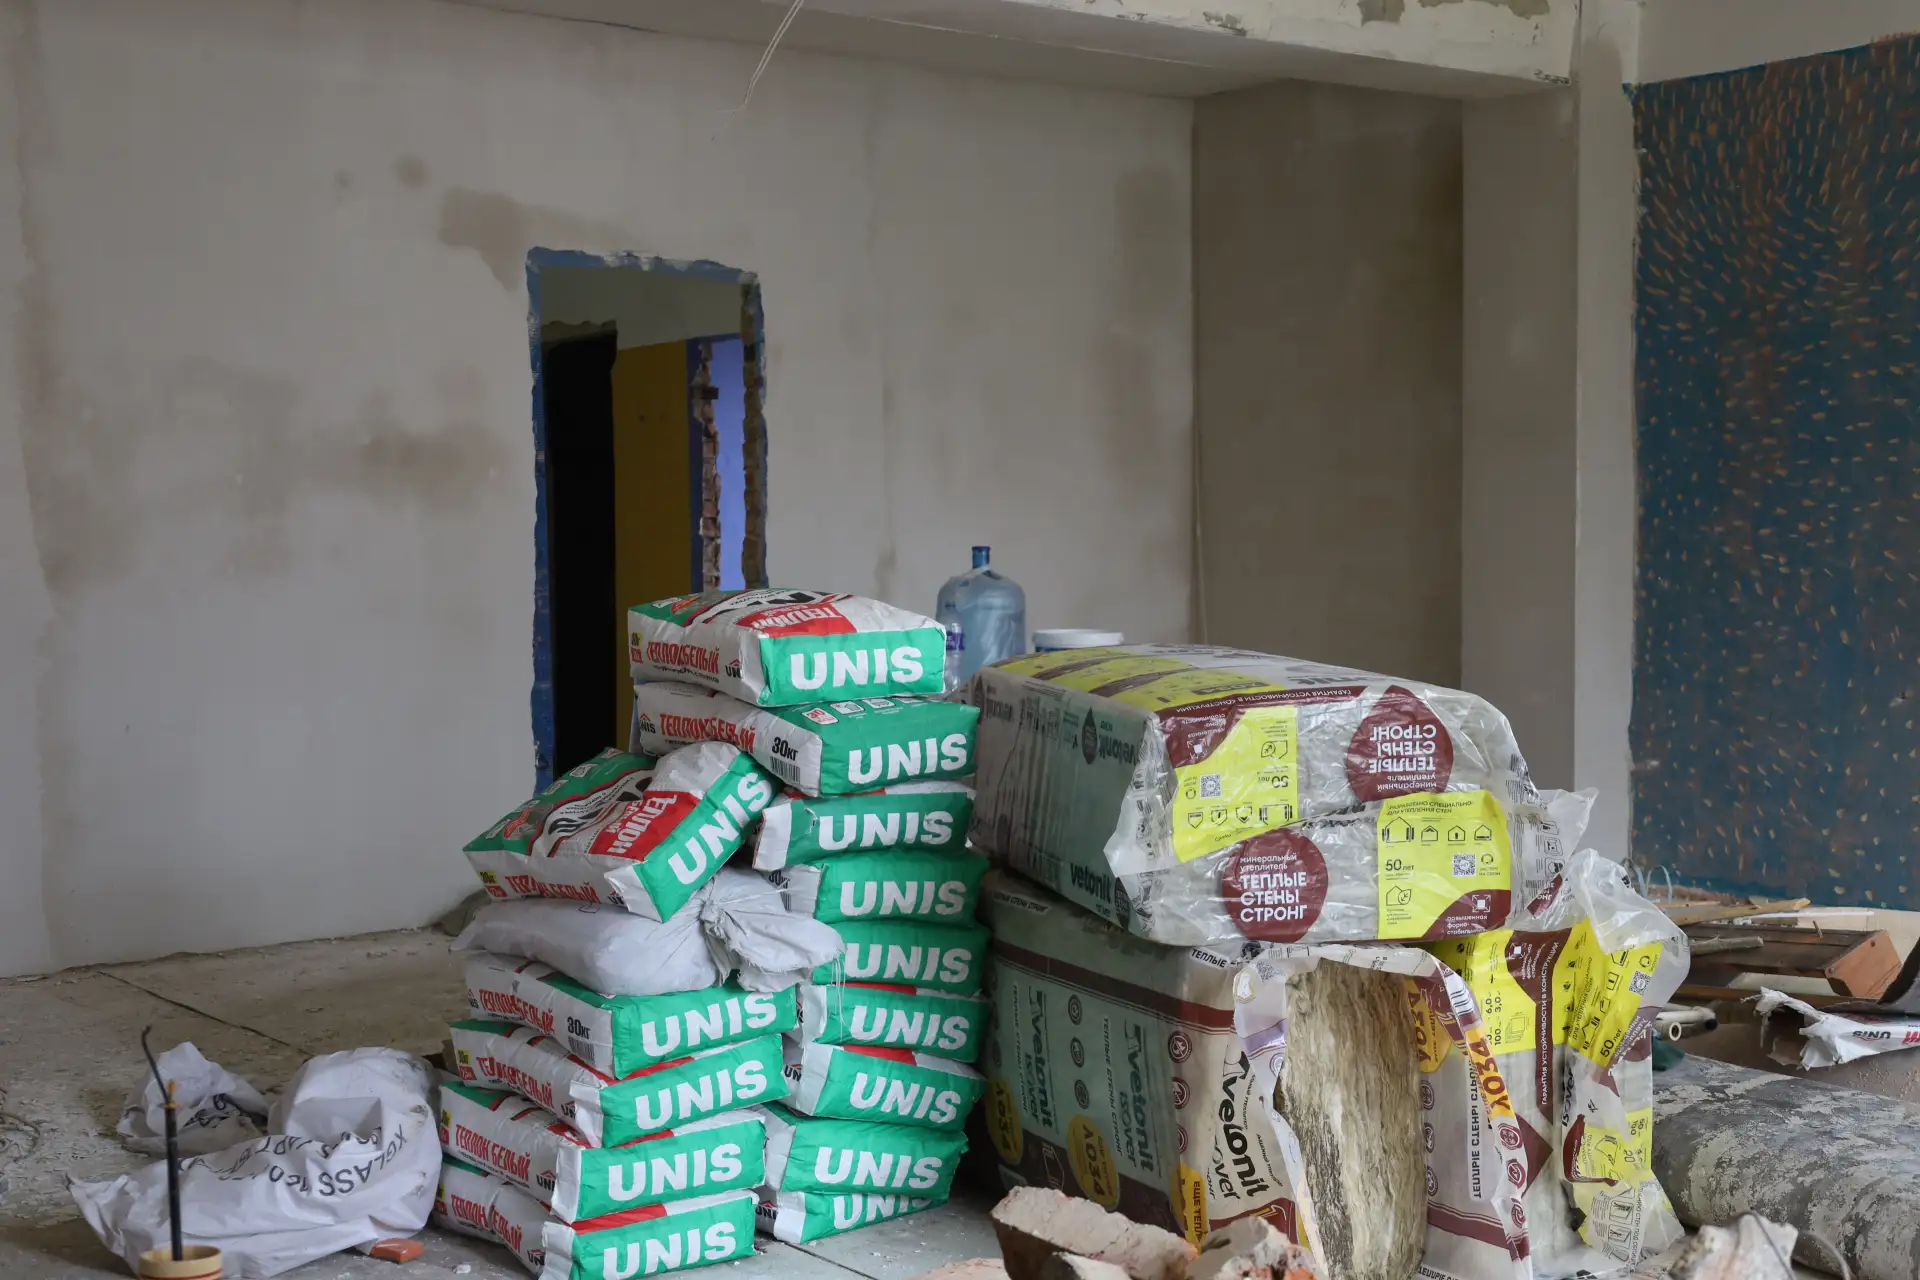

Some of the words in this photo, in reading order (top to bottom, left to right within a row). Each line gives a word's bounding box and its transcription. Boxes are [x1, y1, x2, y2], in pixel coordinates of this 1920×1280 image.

[725, 665, 743, 678] UN
[790, 646, 924, 690] UNIS
[1245, 690, 1311, 704] УСТОЙЧИВОСТИ
[1312, 688, 1352, 698] ГАРАНТИЯ
[1370, 724, 1437, 740] СТРОНГ
[772, 736, 799, 761] 30кг
[848, 733, 968, 785] UNIS
[1377, 740, 1436, 756] СТЕНЫ
[1368, 757, 1436, 773] ТЕПЛЫЕ
[1387, 772, 1436, 781] утеплитель
[1271, 775, 1289, 788] 50
[1377, 782, 1437, 792] минеральный
[616, 793, 679, 853] ТЕПЛОН
[667, 771, 772, 886] UNIS
[818, 810, 954, 850] UNIS
[1240, 853, 1297, 863] минеральный
[1240, 863, 1288, 873] утеплитель
[1385, 859, 1402, 871] 50
[1070, 863, 1112, 905] vetonit
[1240, 871, 1307, 890] ТЕПЛЫЕ
[839, 880, 968, 917] UNIS
[1240, 889, 1300, 906] СТЕНЫ
[1240, 904, 1307, 923] СТРОНГ
[844, 943, 973, 984] UNIS
[1190, 948, 1228, 969] ТЕПЛЫЕ
[1542, 942, 1560, 993] КОНСТРУКЦИИ
[567, 1016, 591, 1040] 30кг
[641, 991, 777, 1057] UNIS
[849, 1005, 970, 1050] UNIS
[1494, 1028, 1502, 1046] 100
[1851, 1030, 1892, 1040] UNIS
[1600, 1040, 1614, 1058] 50
[1613, 1028, 1622, 1042] лет
[784, 1065, 802, 1082] UN
[1030, 1014, 1053, 1128] vetonit
[635, 1059, 768, 1130] UNIS
[849, 1072, 961, 1124] UNIS
[1561, 1068, 1574, 1127] isover
[1127, 1053, 1155, 1173] vetonit
[1219, 1075, 1270, 1198] vetonit
[456, 1124, 490, 1161] ТЕПЛОН
[491, 1142, 532, 1182] БЕЛЫЙ
[608, 1143, 742, 1201] UNIS
[814, 1146, 942, 1190] UNIS
[536, 1174, 556, 1192] UNI
[1193, 1180, 1201, 1206] ЕЩЕ
[451, 1194, 489, 1228] ТЕПЛОН
[527, 1250, 546, 1266] UN
[602, 1221, 738, 1280] UNIS
